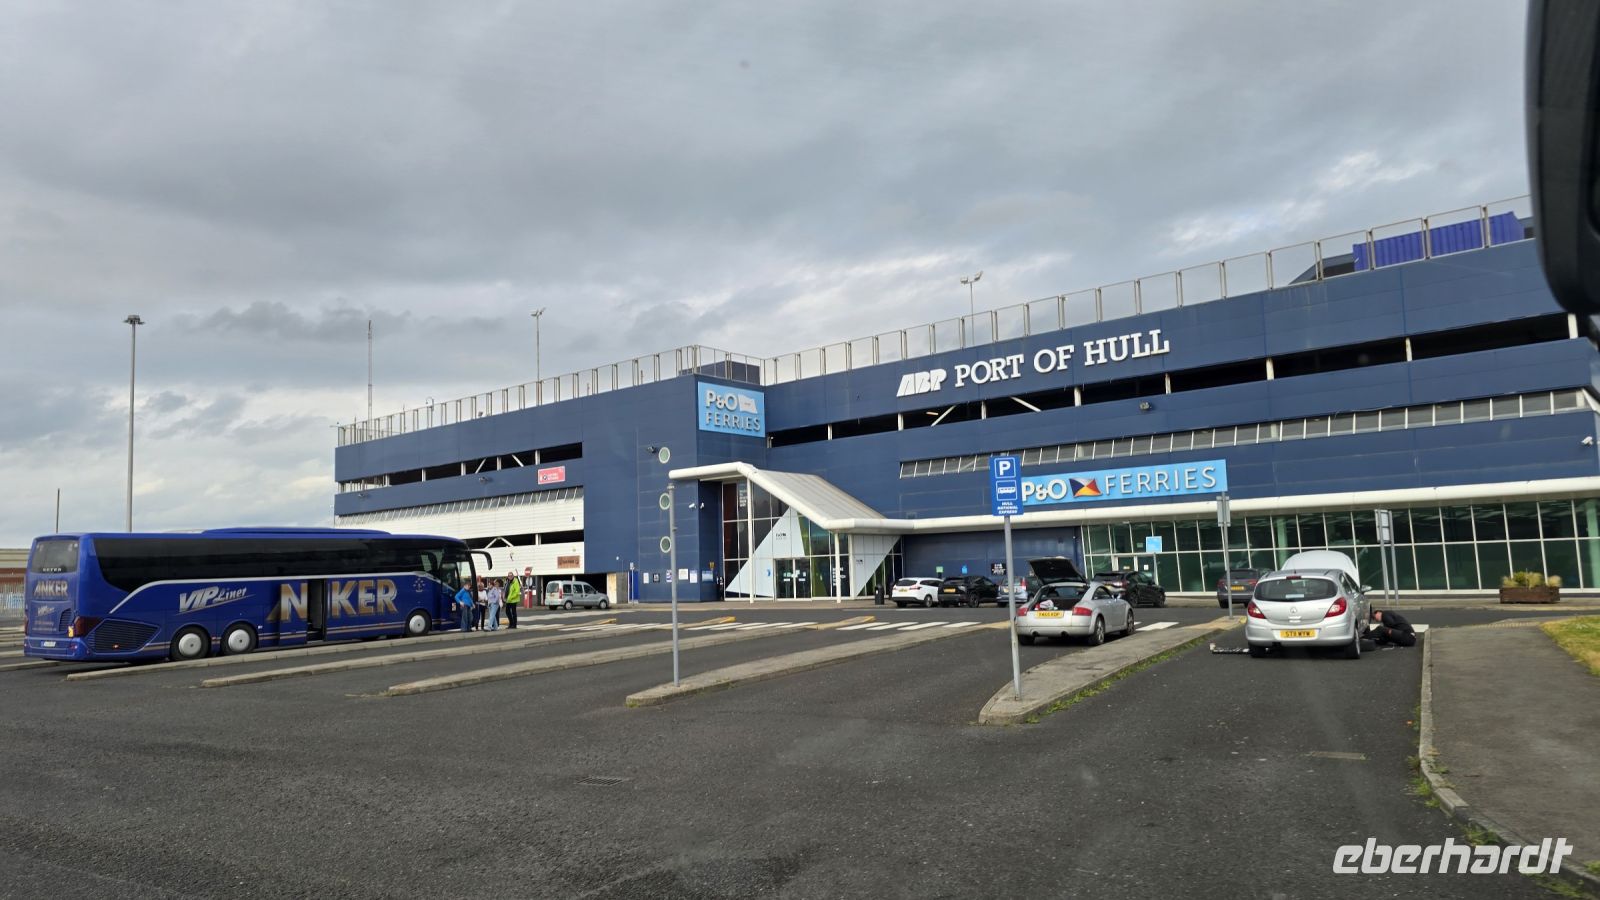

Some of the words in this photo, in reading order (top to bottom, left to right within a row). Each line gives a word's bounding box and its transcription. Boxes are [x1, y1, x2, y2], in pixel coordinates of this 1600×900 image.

[896, 368, 947, 397] ABP
[954, 353, 1025, 388] PORT
[1033, 344, 1075, 374] OF
[1083, 328, 1170, 366] HULL
[705, 388, 738, 412] P&O
[705, 410, 761, 432] FERRIES
[999, 460, 1011, 476] P
[1021, 479, 1068, 502] P&O
[1105, 466, 1217, 495] FERRIES
[33, 580, 69, 597] ANKER
[178, 586, 220, 612] VIP
